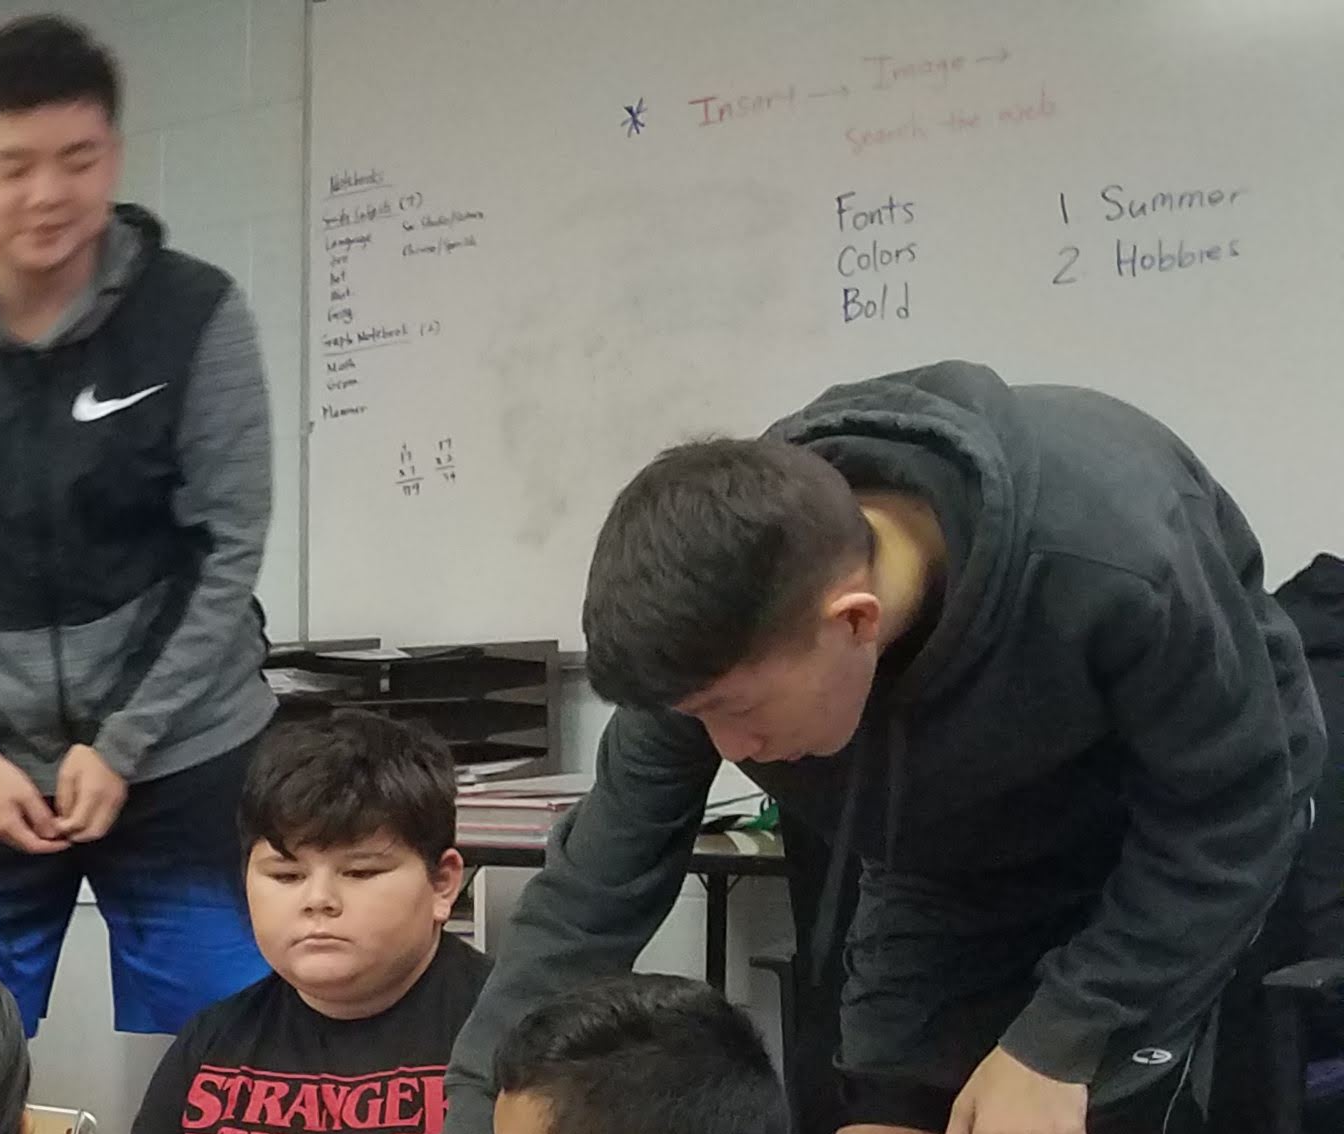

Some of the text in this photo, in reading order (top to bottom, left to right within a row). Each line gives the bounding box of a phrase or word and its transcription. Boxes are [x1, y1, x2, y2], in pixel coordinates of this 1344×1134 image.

[835, 192, 916, 232] Fonts
[1059, 184, 1246, 223] 1 Summer
[837, 241, 919, 278] Colors
[1052, 239, 1241, 285] 2 Hobbies
[843, 282, 911, 323] Bold
